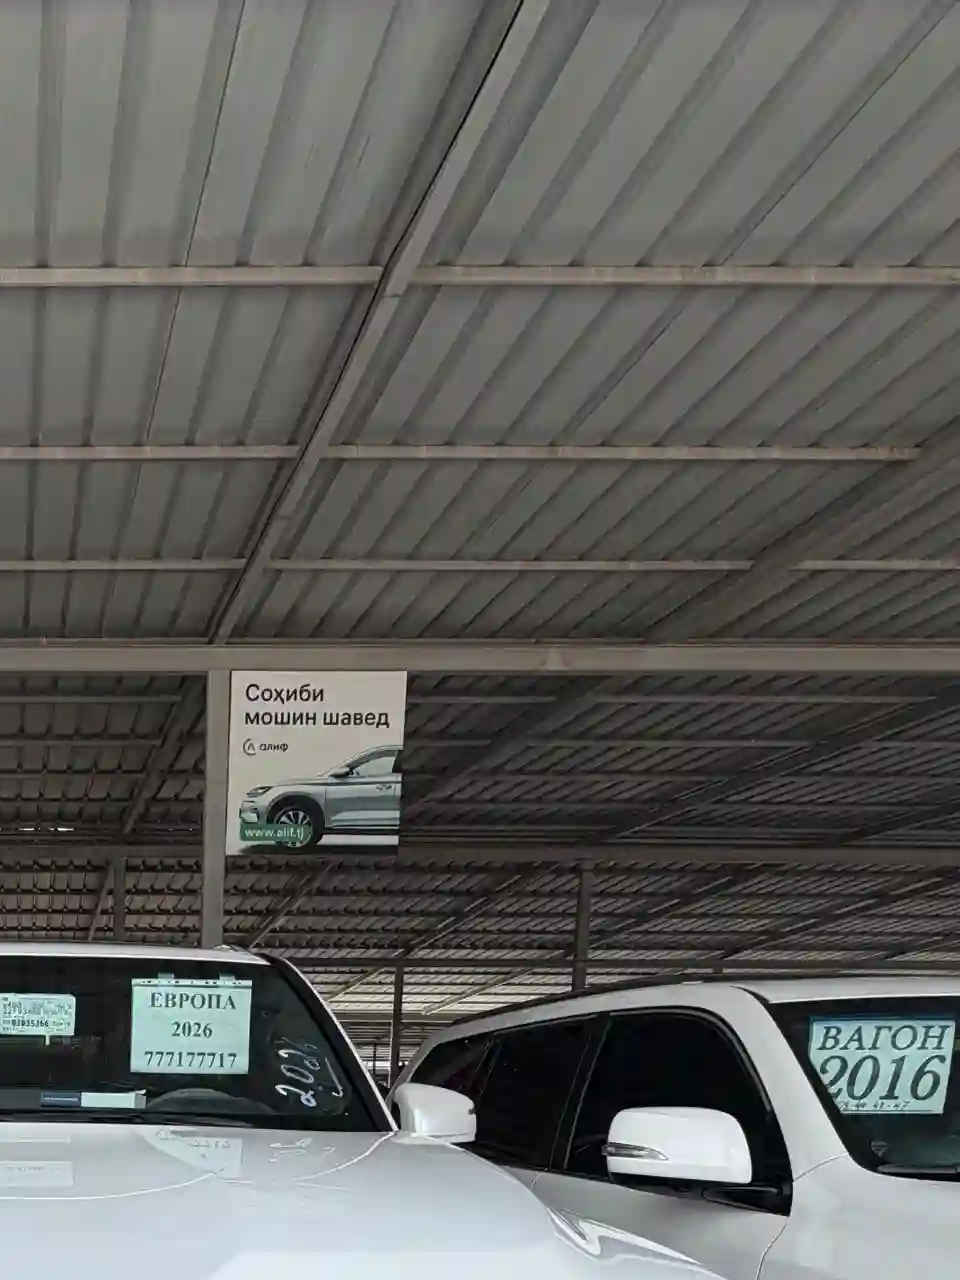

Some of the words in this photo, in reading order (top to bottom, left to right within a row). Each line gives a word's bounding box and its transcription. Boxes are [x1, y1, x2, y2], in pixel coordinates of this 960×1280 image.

[245, 683, 325, 705] Соҳиби
[245, 711, 317, 727] мошин
[322, 711, 390, 728] шавед
[259, 742, 289, 753] алиф
[244, 827, 305, 840] www.alif.tj
[148, 991, 237, 1011] ЕВРОПА
[171, 1021, 213, 1039] 2026
[817, 1025, 949, 1050] ВАГОН
[143, 1050, 237, 1069] 777177717
[819, 1054, 947, 1101] 2016
